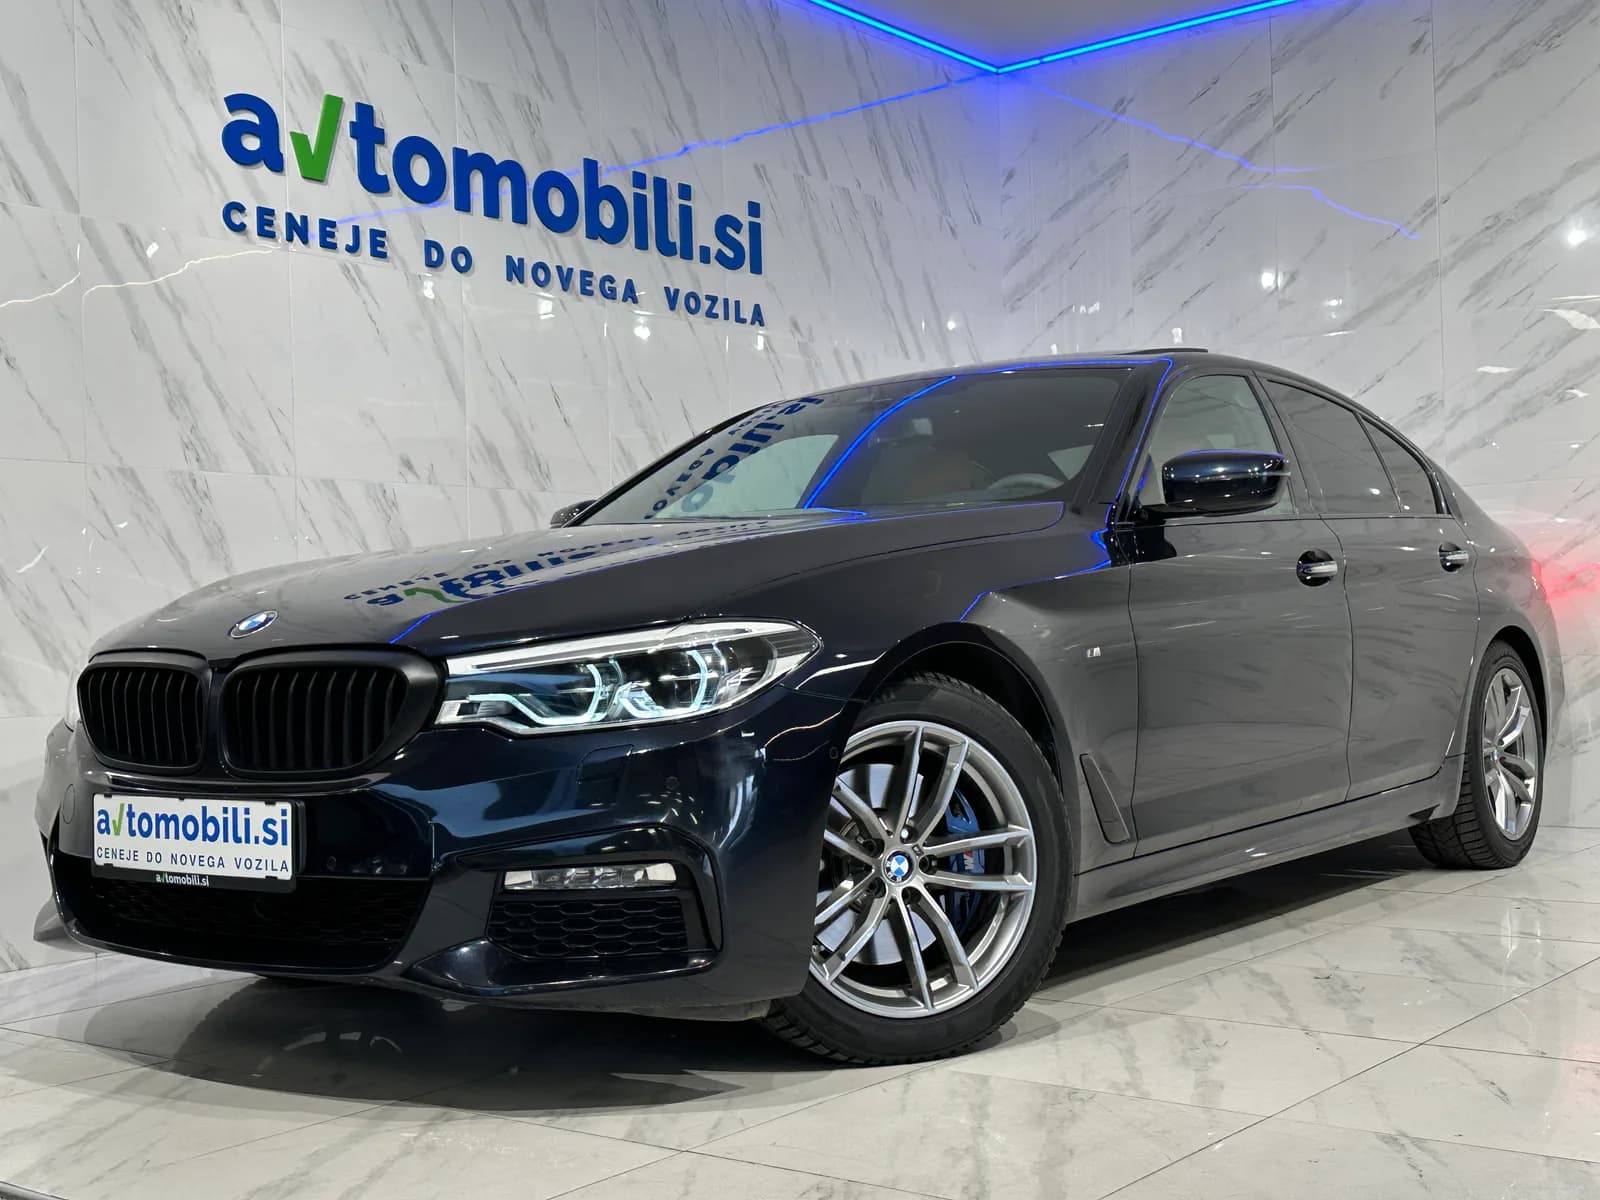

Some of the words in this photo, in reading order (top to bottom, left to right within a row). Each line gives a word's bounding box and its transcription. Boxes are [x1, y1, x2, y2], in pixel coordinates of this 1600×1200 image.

[221, 200, 389, 259] CENEJE
[424, 239, 473, 273] DO
[505, 254, 639, 305] NOVEGA
[663, 286, 765, 327] VOZILA
[96, 846, 139, 862] CENEJE
[146, 851, 162, 864] DO
[170, 853, 225, 869] NOVEGA
[234, 857, 289, 873] VOZILA
